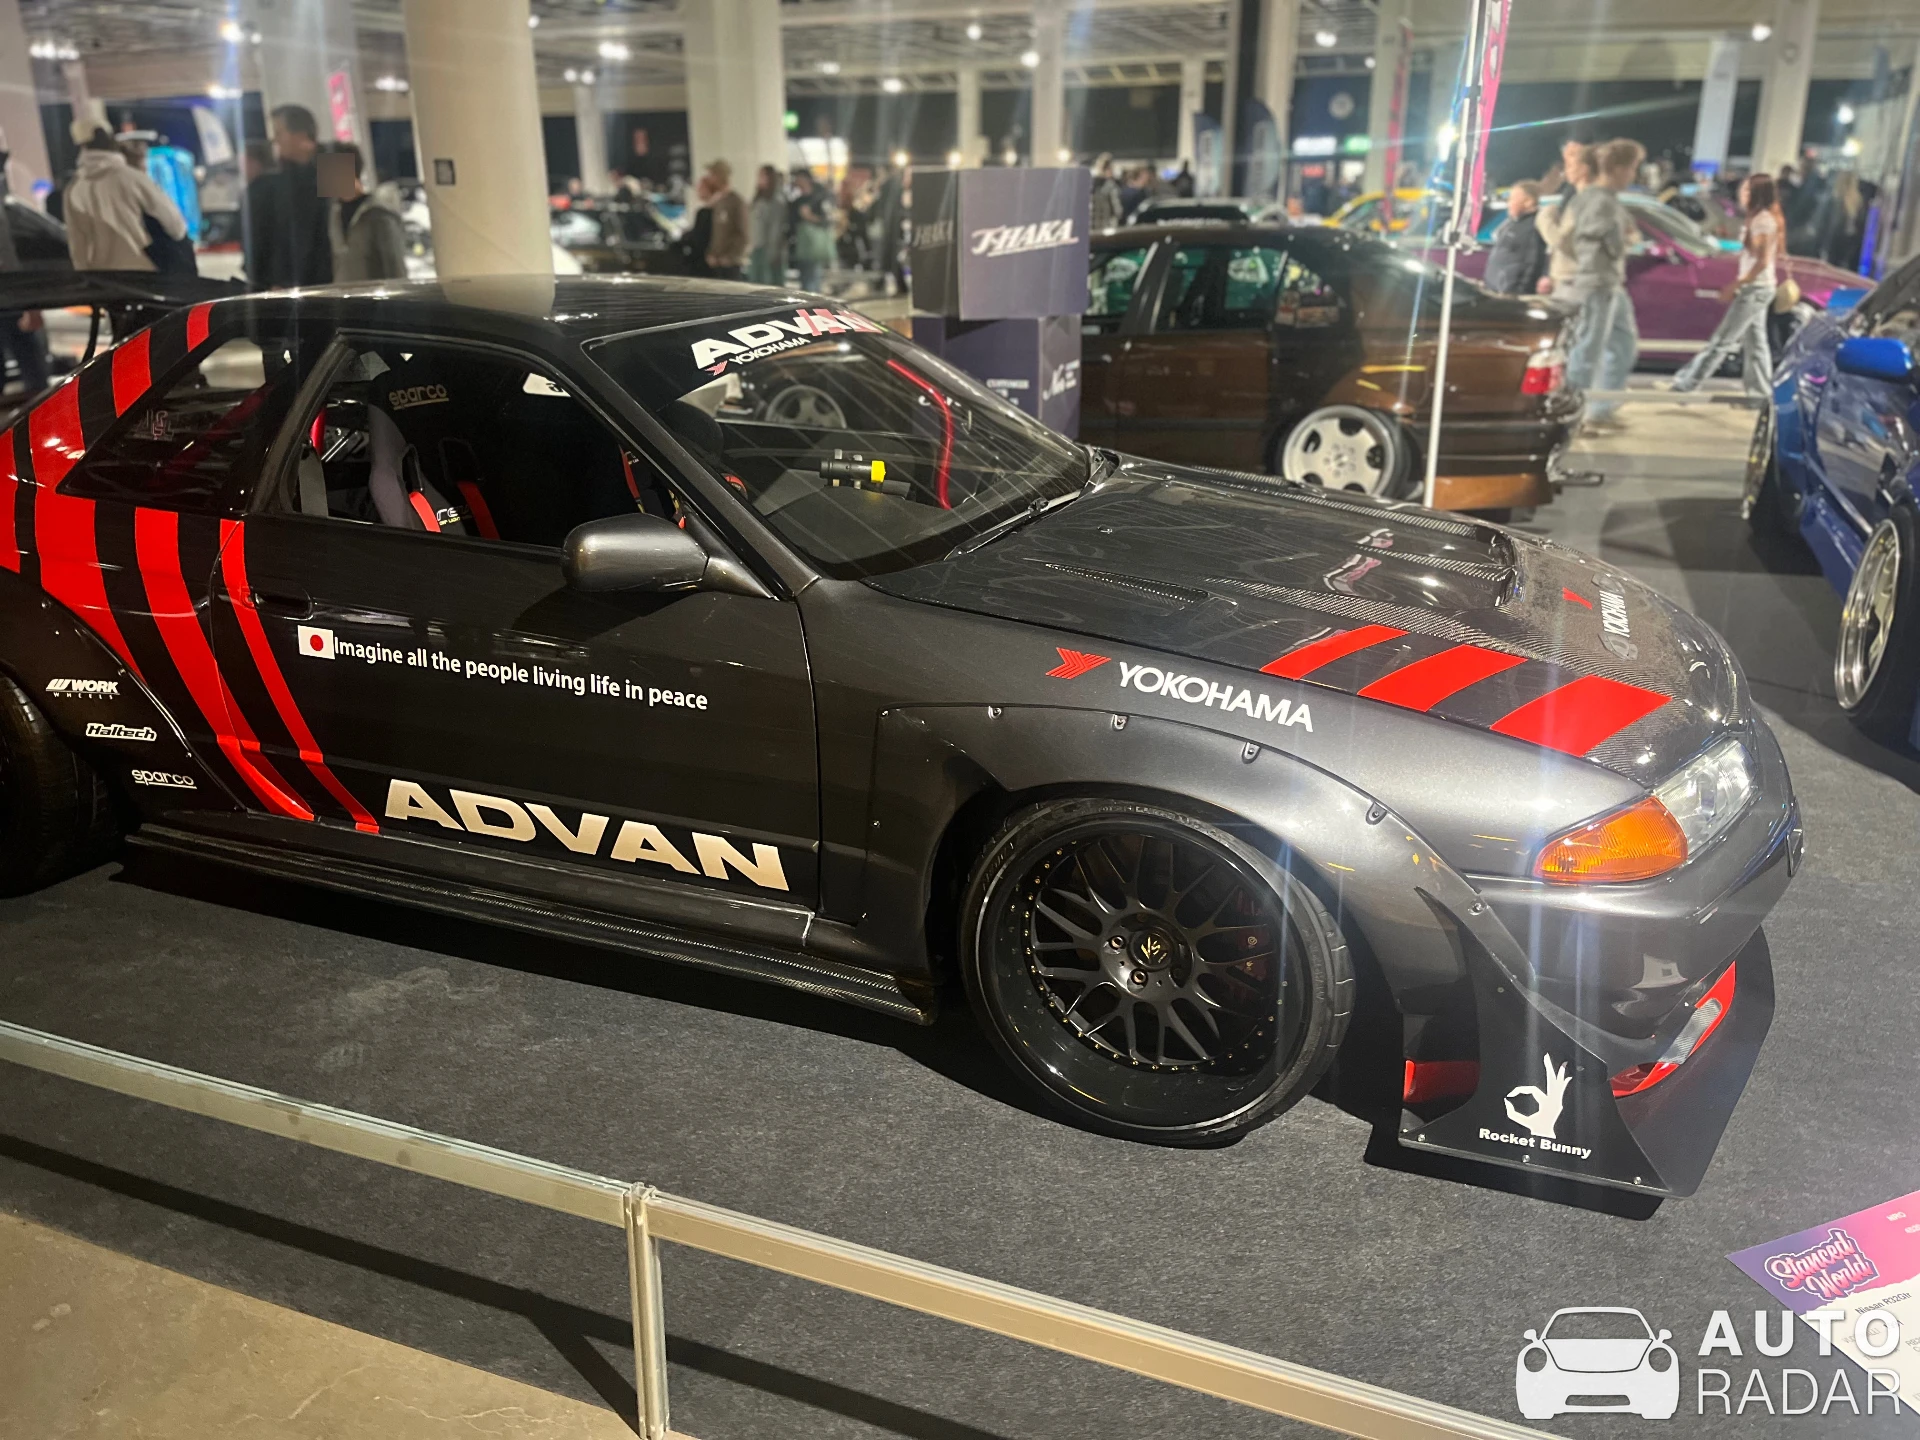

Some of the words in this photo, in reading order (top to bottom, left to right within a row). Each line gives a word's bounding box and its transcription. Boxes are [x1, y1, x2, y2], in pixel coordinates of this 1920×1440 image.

[691, 311, 882, 369] ADVAN
[729, 336, 812, 366] YOKOHAMA
[388, 384, 449, 410] sparco
[1599, 590, 1631, 638] YOKOHAMA
[334, 636, 403, 665] Imagine
[407, 647, 428, 668] all
[430, 651, 461, 673] the
[465, 660, 529, 684] people
[533, 665, 586, 696] living
[590, 673, 621, 697] life
[625, 678, 644, 701] in
[648, 687, 708, 710] peace
[53, 692, 113, 700] WHEELS
[1119, 661, 1313, 732] YOKOHAMA
[87, 724, 156, 740] Haltech
[131, 769, 196, 788] sparco
[385, 779, 790, 891] ADVAN
[1479, 1127, 1536, 1149] Rocket
[1539, 1138, 1592, 1160] Bunny
[1771, 1231, 1855, 1288] Stanced
[1805, 1254, 1874, 1298] World
[1855, 1301, 1885, 1315] Nissan
